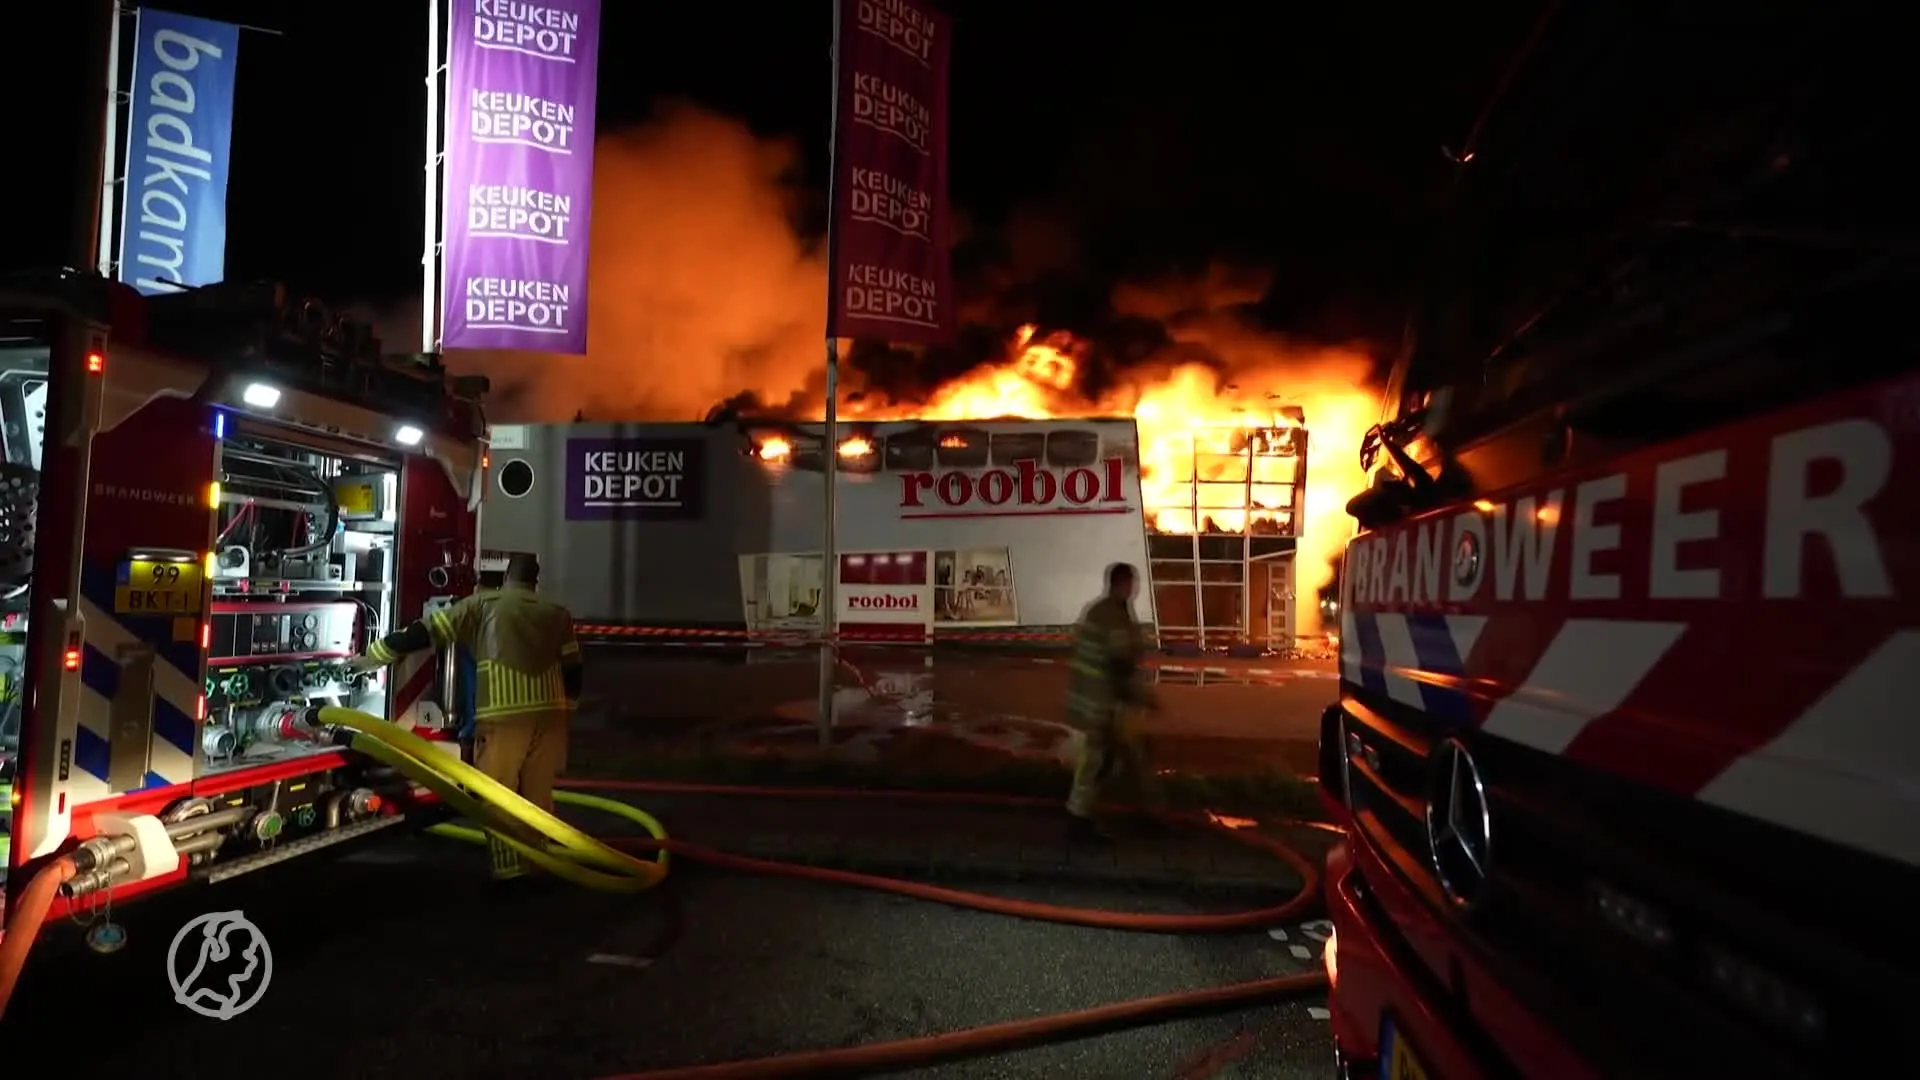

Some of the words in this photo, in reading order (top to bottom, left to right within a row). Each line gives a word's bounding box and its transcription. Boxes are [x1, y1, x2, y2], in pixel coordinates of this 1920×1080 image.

[475, 0, 578, 31] KEUKEN
[858, 0, 934, 59] DEPOT
[474, 15, 577, 54] DEPOT
[472, 88, 574, 124] KEUKEN
[855, 70, 930, 127] KEUKEN
[472, 110, 573, 146] DEPOT
[854, 92, 931, 147] DEPOT
[469, 184, 570, 213] KEUKEN
[852, 166, 931, 211] KEUKEN
[468, 207, 570, 237] DEPOT
[851, 189, 931, 234] DEPOT
[466, 277, 568, 303] KEUKEN
[848, 263, 936, 297] KEUKEN
[466, 298, 568, 326] DEPOT
[846, 287, 937, 321] DEPOT
[585, 451, 684, 472] KEUKEN
[584, 474, 684, 499] DEPOT
[900, 457, 1127, 506] roobol
[1352, 417, 1895, 603] BRANDWEER
[152, 565, 180, 585] 99
[848, 594, 919, 609] roobol
